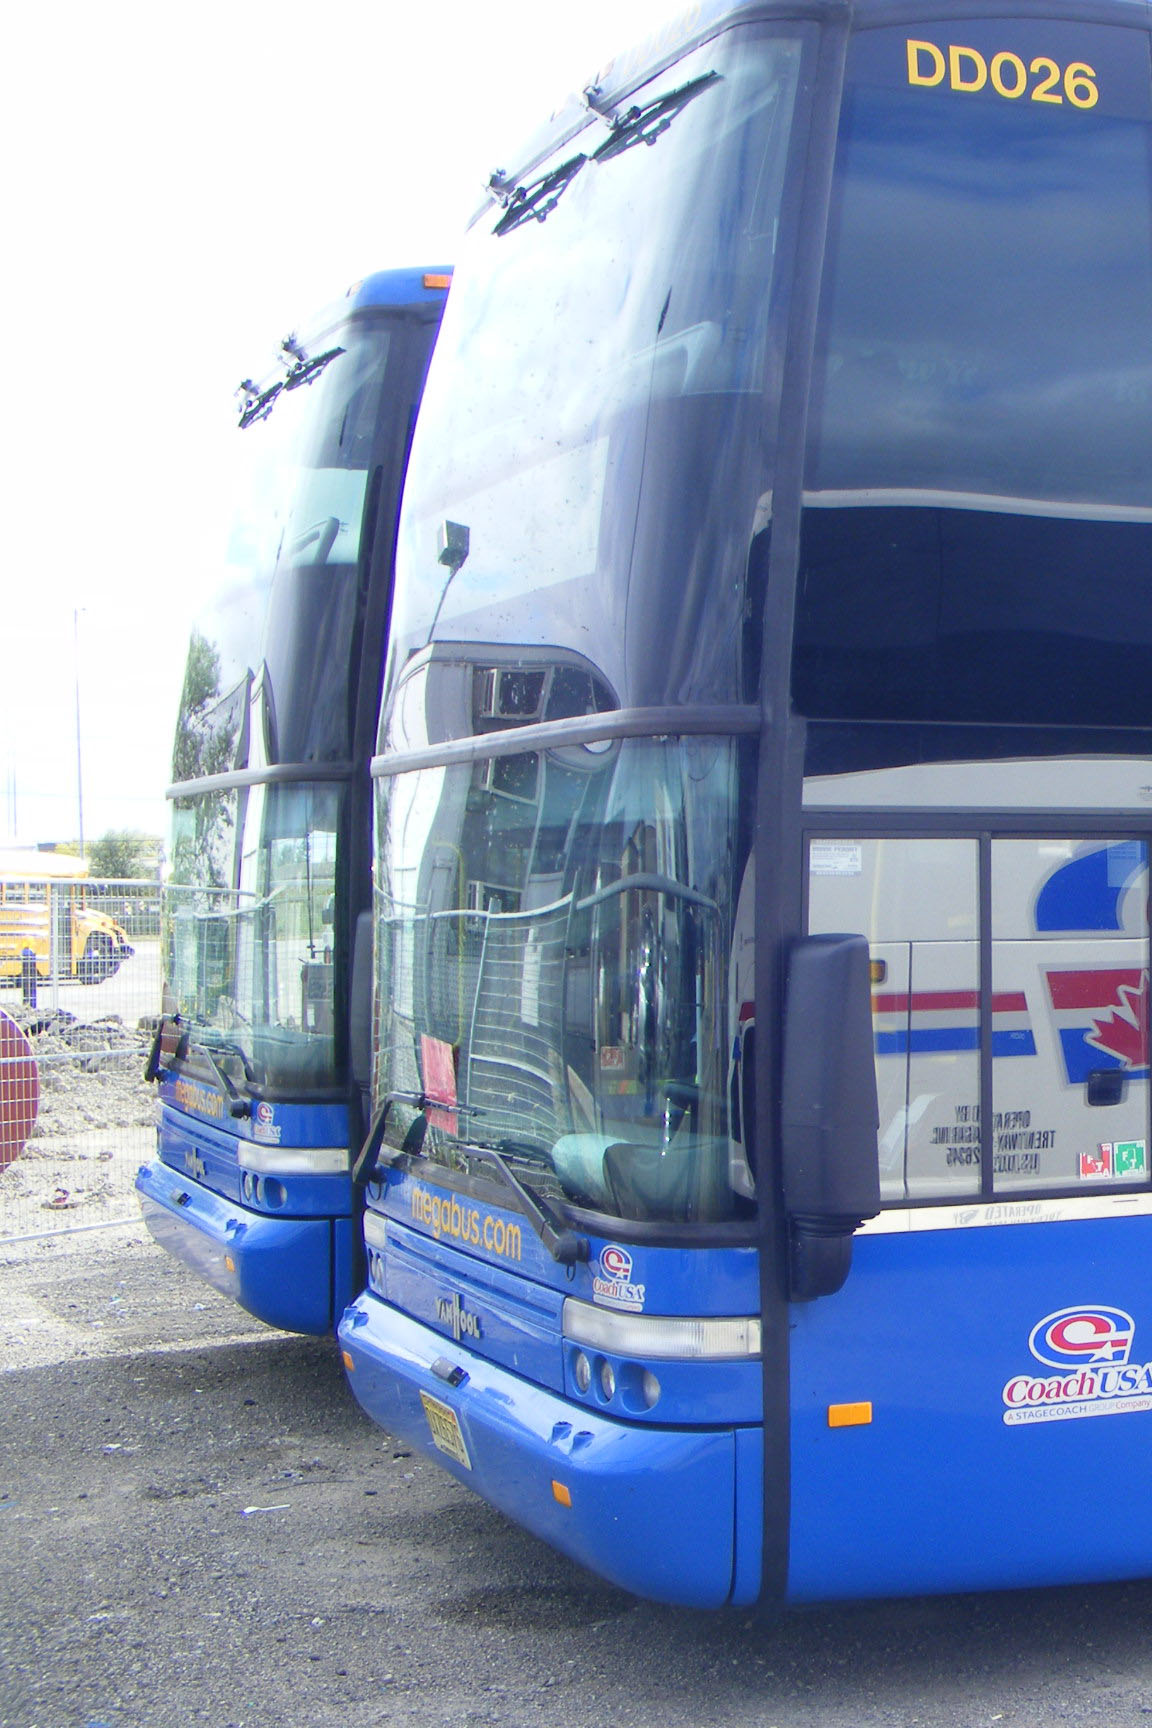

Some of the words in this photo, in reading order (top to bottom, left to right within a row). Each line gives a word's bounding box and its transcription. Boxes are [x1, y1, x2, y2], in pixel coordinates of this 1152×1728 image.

[411, 1187, 522, 1262] megabus.com
[1006, 1372, 1096, 1404] Coach
[1015, 1405, 1088, 1421] STAGECOACH
[1115, 1399, 1151, 1411] Company
